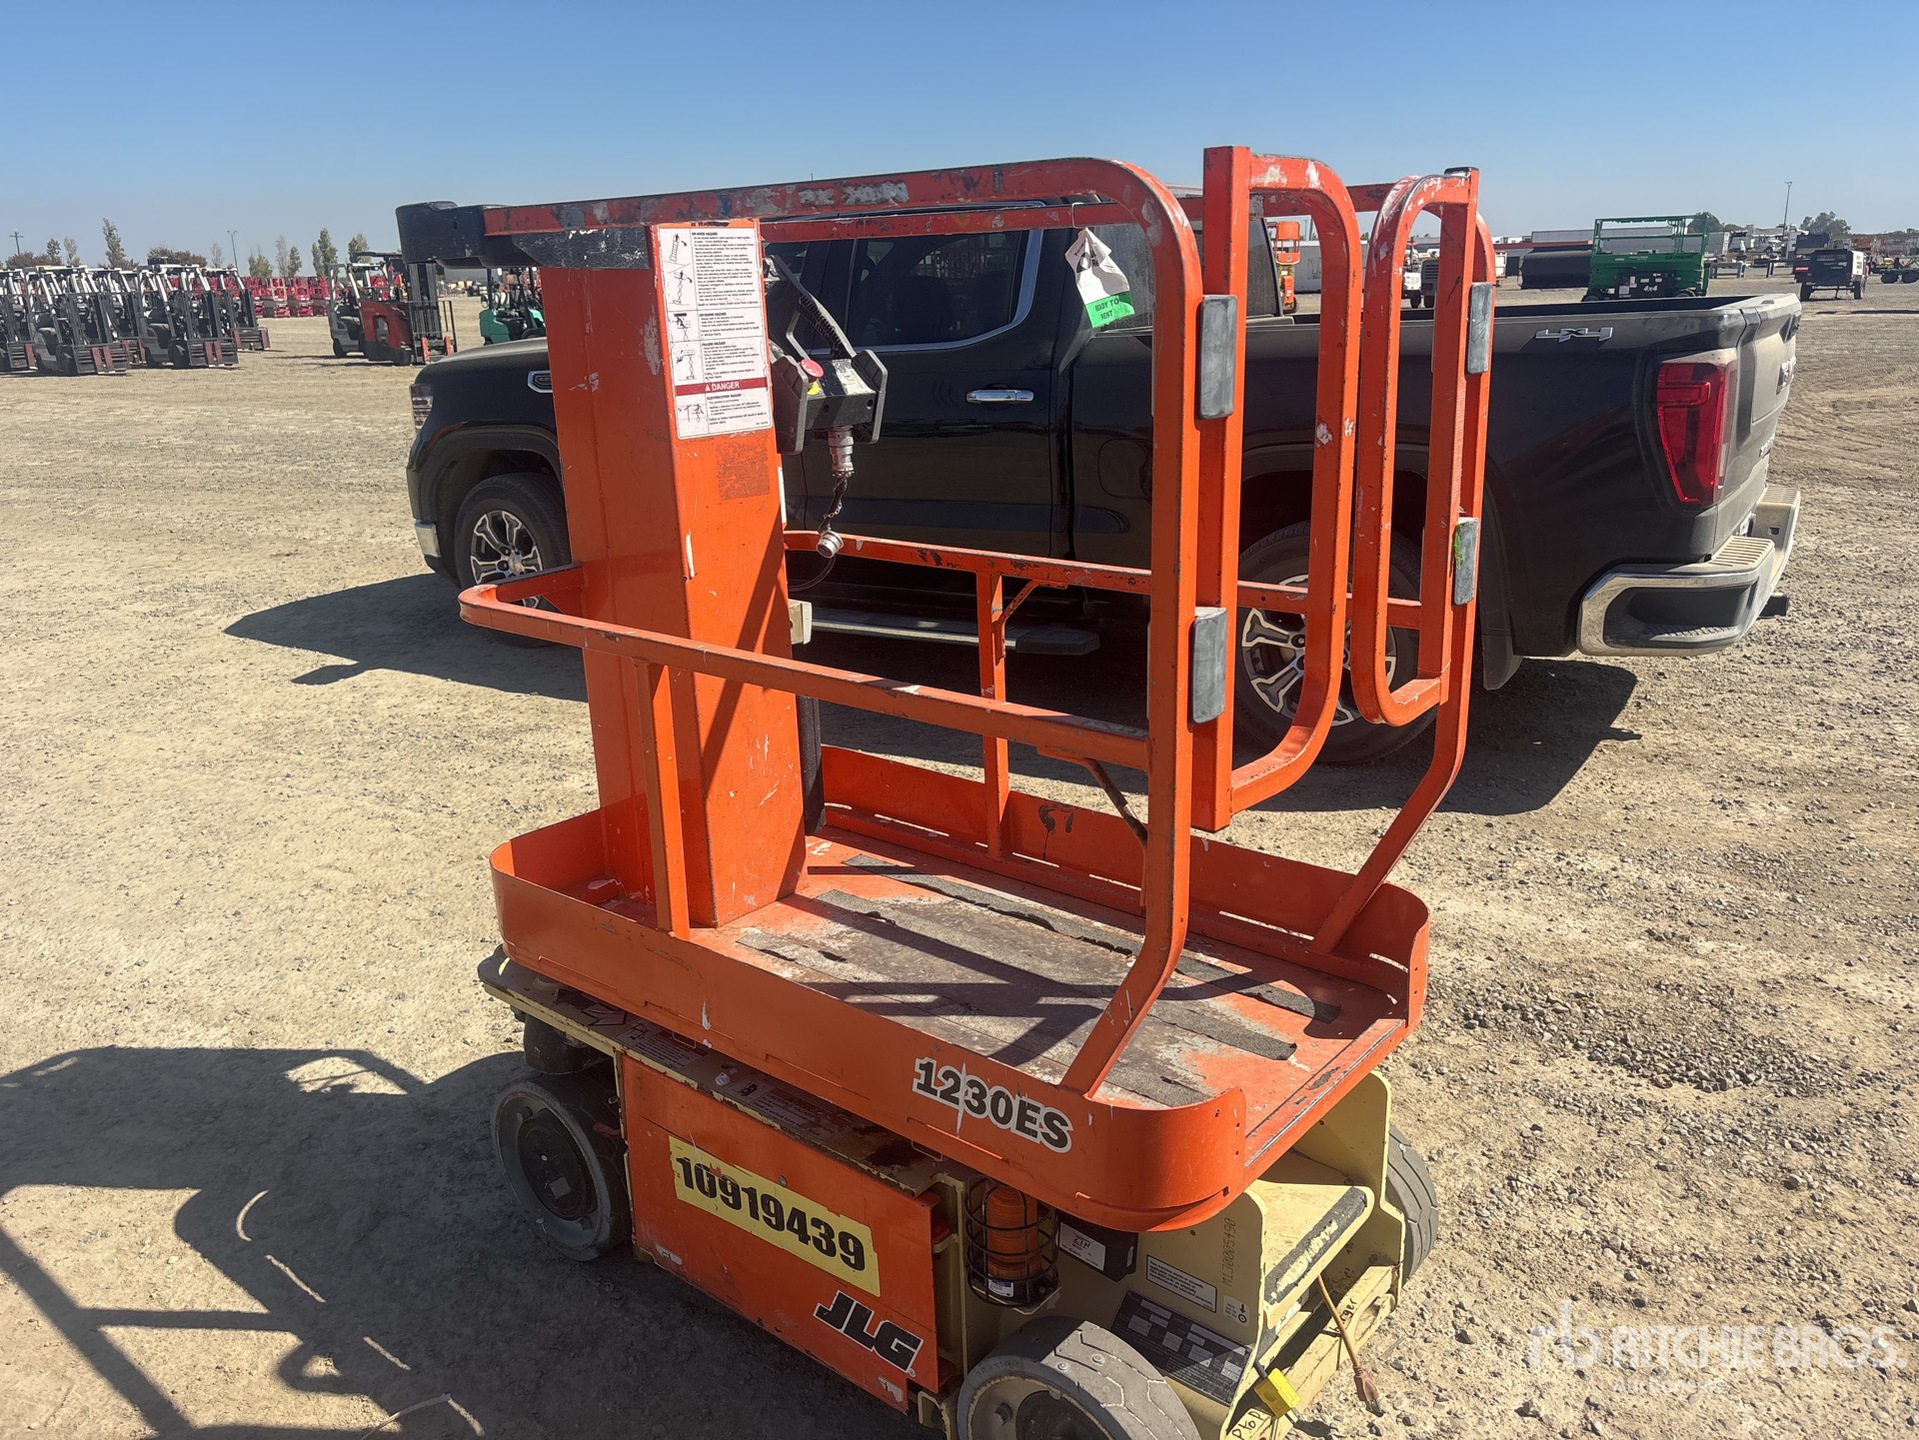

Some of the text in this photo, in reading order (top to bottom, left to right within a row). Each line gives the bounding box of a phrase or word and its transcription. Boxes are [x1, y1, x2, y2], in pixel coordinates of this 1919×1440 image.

[1109, 298, 1120, 307] TO
[711, 381, 740, 391] DANGER
[914, 1059, 1071, 1150] 1230ES
[676, 1156, 866, 1272] 10919439
[813, 1290, 925, 1374] JLG
